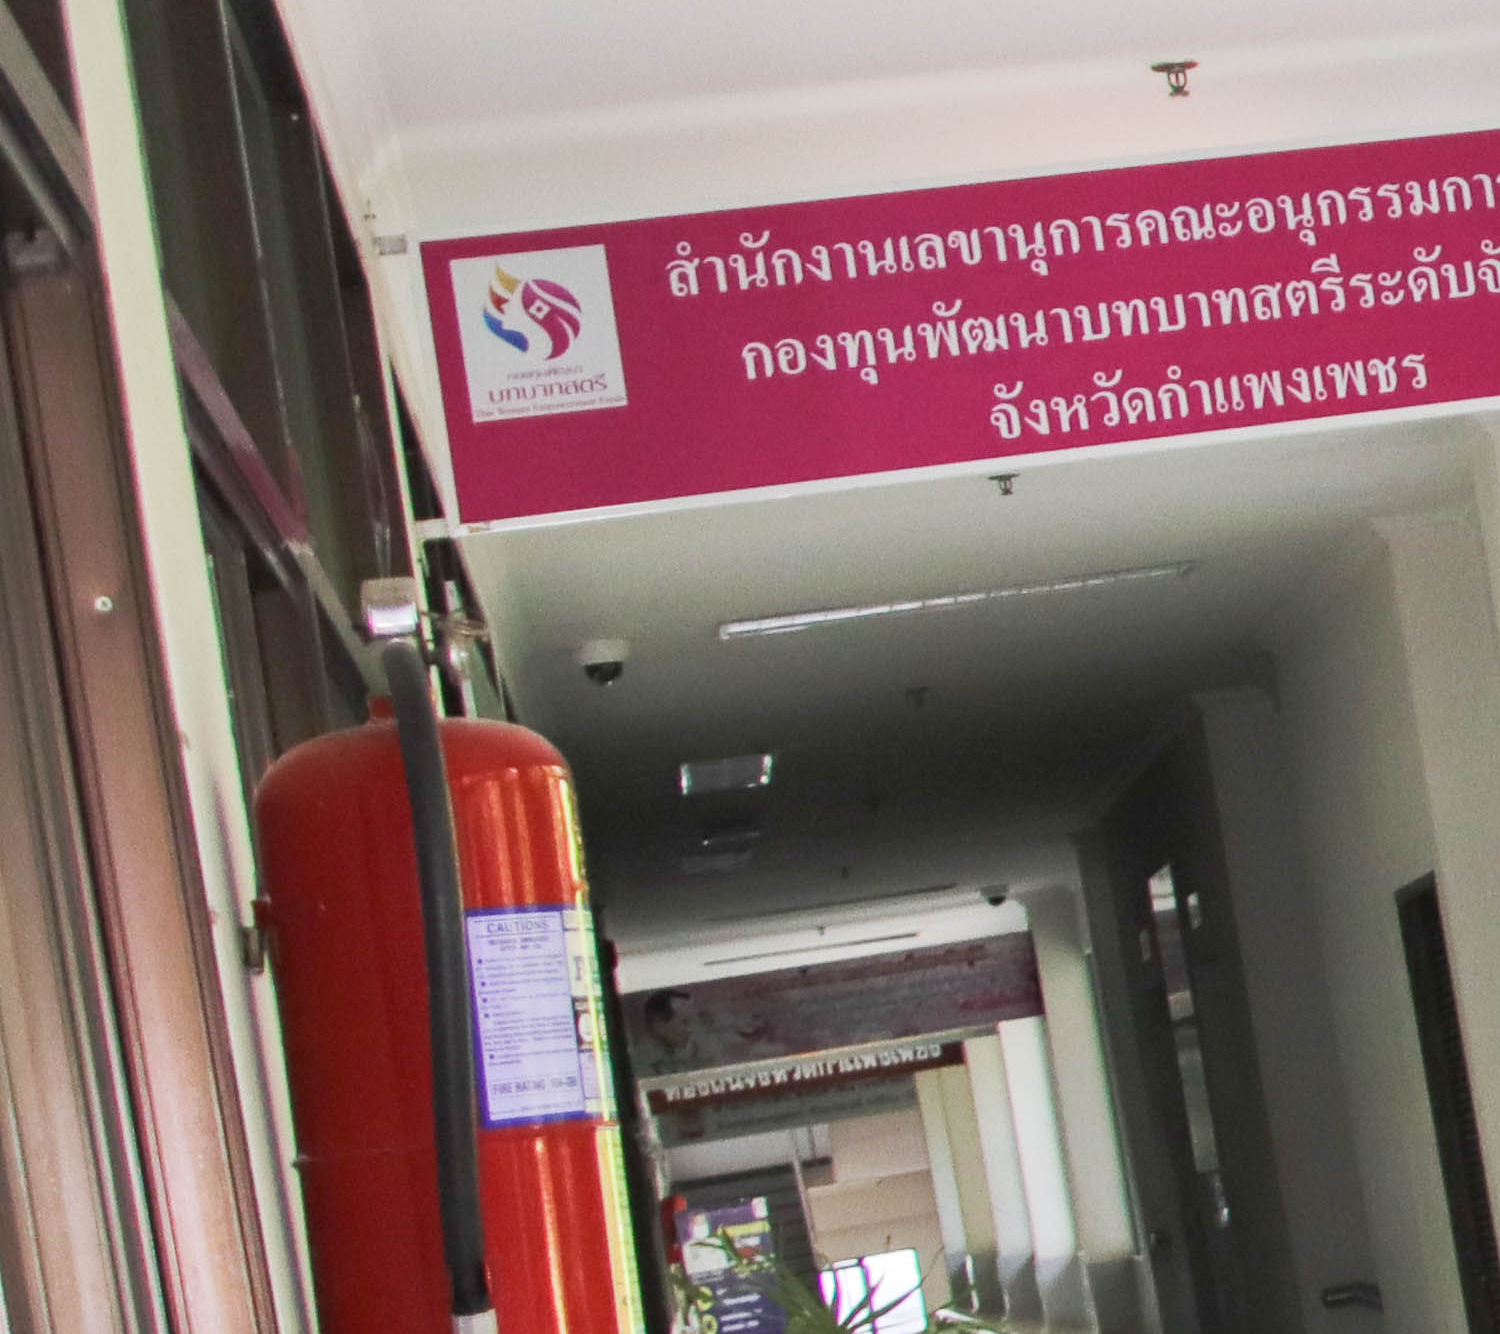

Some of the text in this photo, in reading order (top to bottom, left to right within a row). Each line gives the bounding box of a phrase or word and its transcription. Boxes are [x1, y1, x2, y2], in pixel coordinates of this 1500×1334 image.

[488, 372, 608, 404] บทบาทสตรี
[991, 352, 1428, 439] จังหวัดกำแพงเพชร
[486, 921, 550, 934] CAUTIONS
